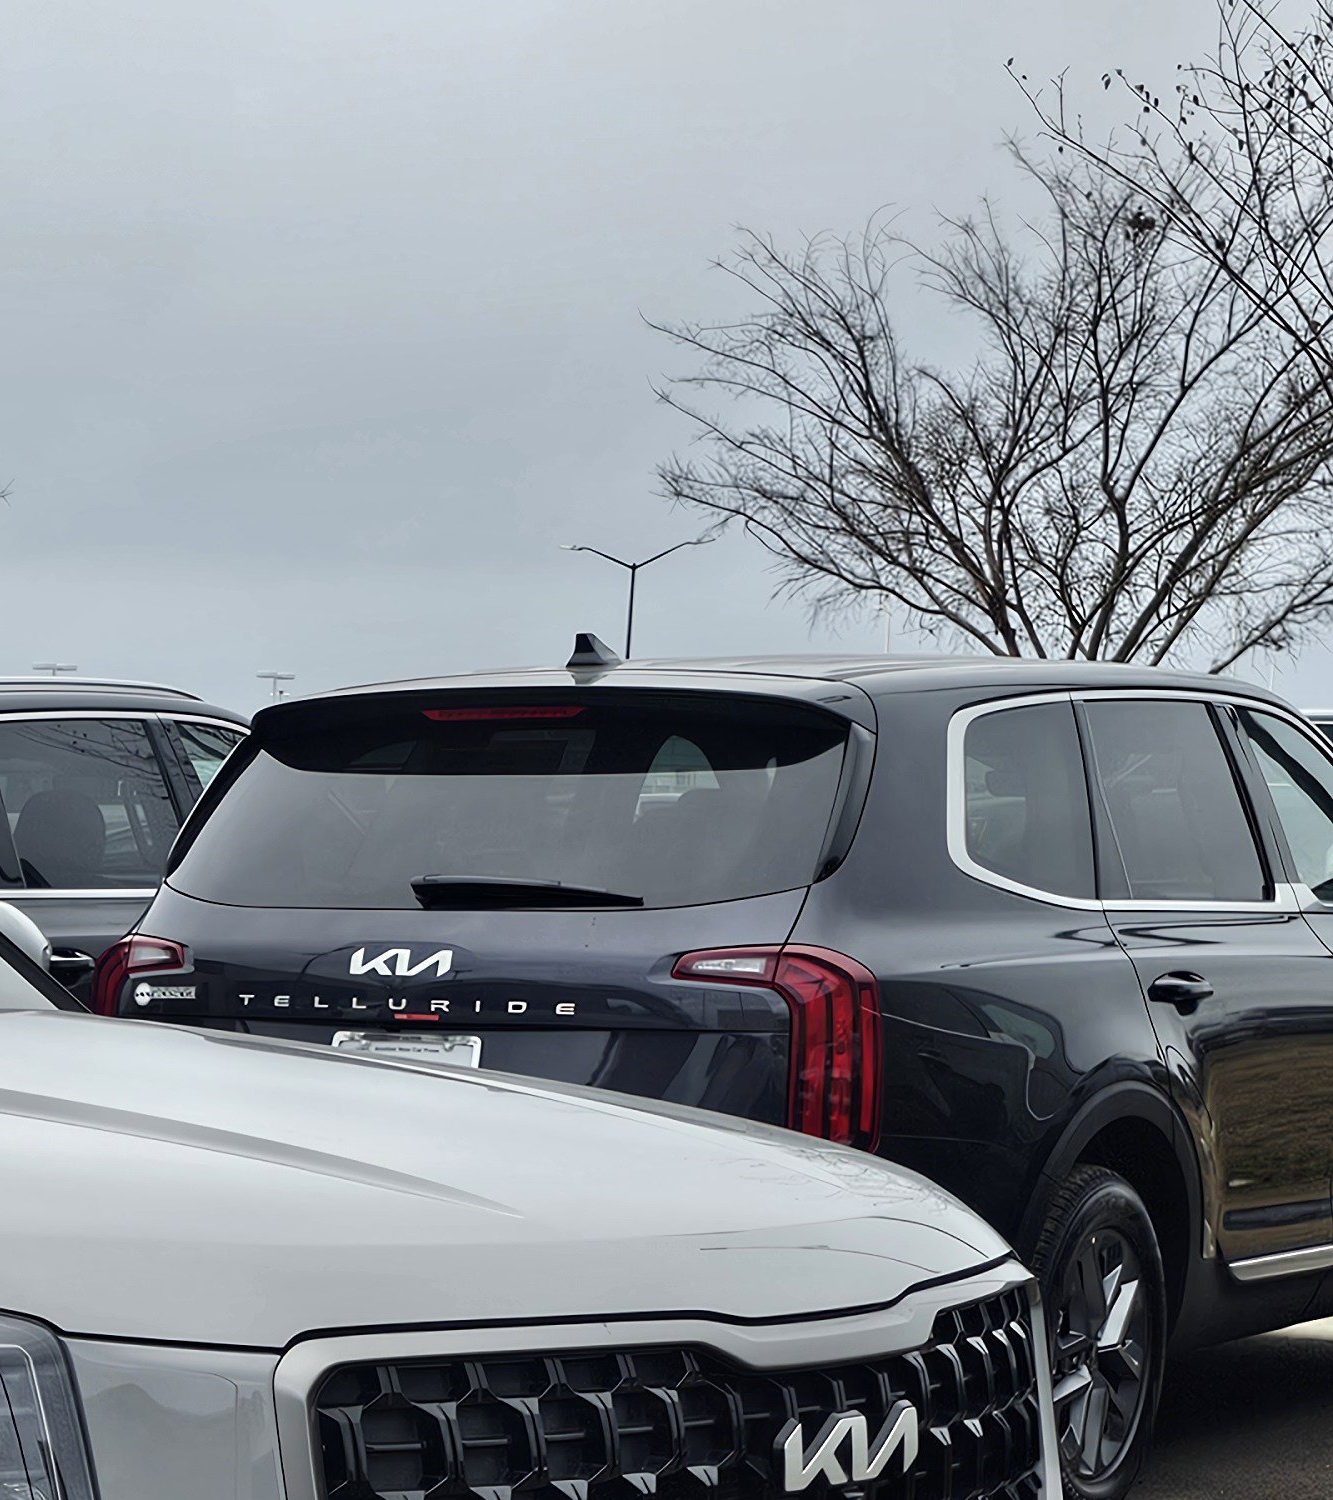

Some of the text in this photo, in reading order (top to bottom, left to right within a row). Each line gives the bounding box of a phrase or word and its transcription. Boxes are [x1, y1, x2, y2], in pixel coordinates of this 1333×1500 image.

[349, 947, 453, 977] KIA
[238, 994, 576, 1015] TELLURIDE
[776, 1400, 919, 1492] KIA
